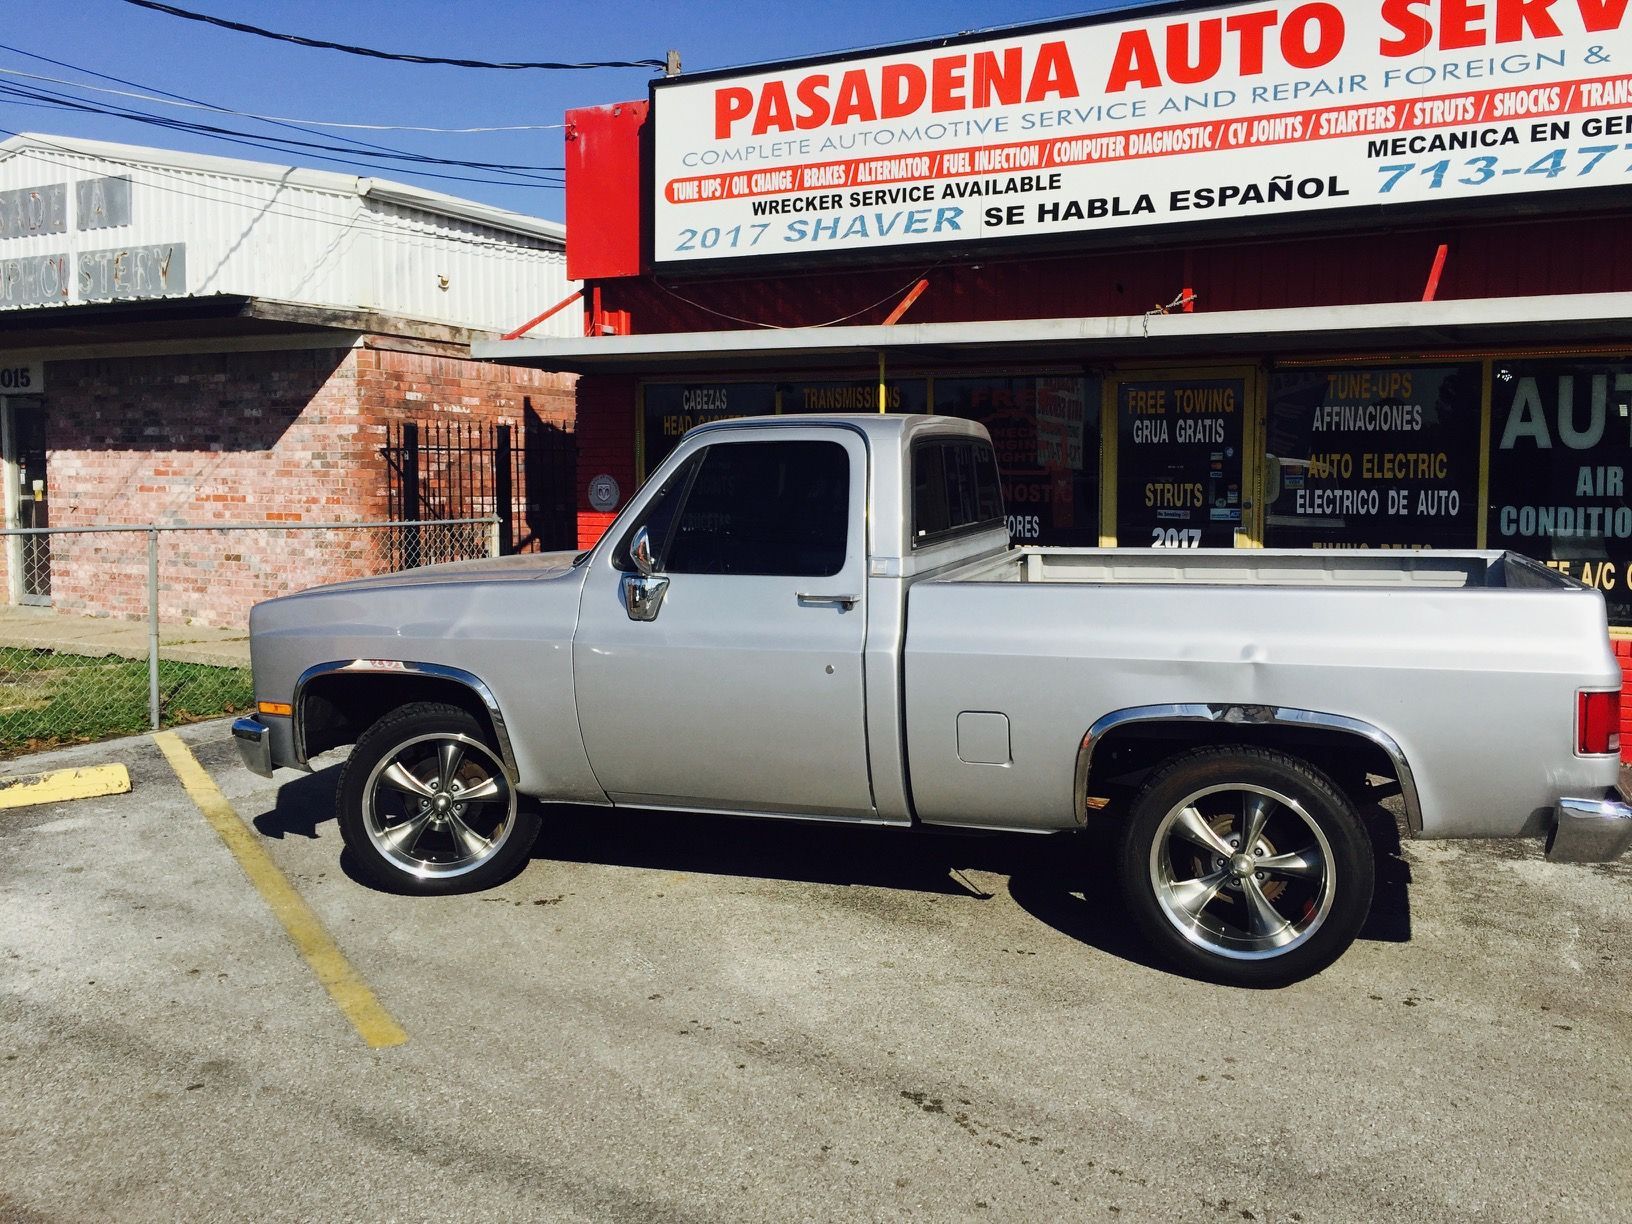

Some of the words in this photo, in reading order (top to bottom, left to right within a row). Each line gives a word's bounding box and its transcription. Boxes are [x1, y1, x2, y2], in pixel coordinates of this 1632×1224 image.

[715, 41, 1080, 139] PASADENA
[1105, 2, 1345, 93] AUTO
[682, 139, 811, 167] COMPLETE
[820, 117, 1009, 152] AUTOMOTIVE
[1021, 101, 1147, 130] SERVICE
[1158, 90, 1237, 114] AND
[1252, 74, 1369, 104] REPAIR
[1384, 49, 1566, 88] FOREIGN
[1584, 45, 1612, 64] &
[673, 182, 699, 200] TUNE
[701, 178, 721, 198] UPS
[731, 177, 749, 195] OIL
[751, 170, 793, 192] CHANGE
[803, 165, 846, 187] BRAKES
[857, 156, 930, 182] ALTERNATOR
[943, 153, 971, 174] FUEL
[974, 145, 1039, 171] INJECTION
[1053, 135, 1126, 163] COMPUTER
[1128, 125, 1212, 156] DIAGNOSTIC
[1228, 122, 1248, 145] CV
[1250, 115, 1303, 143] JOINTS
[1319, 105, 1396, 136] STARTERS
[1413, 96, 1475, 126] STRUTS
[1493, 86, 1561, 118] SHOCKS
[1367, 127, 1520, 158] MECANICA
[1530, 121, 1571, 142] EN
[1581, 115, 1632, 137] GE
[1377, 143, 1632, 193] 713-47
[752, 194, 843, 216] WRECKER
[850, 185, 935, 207] SERVICE
[942, 174, 1062, 200] AVAILABLE
[984, 205, 1025, 227] SE
[1038, 194, 1156, 223] HABLA
[1169, 174, 1350, 211] ESPAÑOL
[675, 222, 771, 251] 2017
[783, 206, 964, 242] SHAVER
[682, 388, 728, 411] CABEZAS
[1327, 372, 1413, 400] TUNE-UPS
[1127, 390, 1166, 415] FREE
[1174, 388, 1235, 414] TOWING
[1133, 419, 1169, 444] GRUA
[1176, 418, 1225, 444] GRATIS
[1312, 404, 1422, 432] AFFINACIONES
[1308, 452, 1353, 479] AUTO
[1362, 451, 1448, 479] ELECTRIC
[1145, 482, 1203, 508] STRUTS
[1575, 466, 1624, 496] AIR
[1296, 489, 1379, 515] ELECTRICO
[1388, 489, 1409, 516] DE
[1417, 490, 1460, 516] AUTO
[1151, 527, 1202, 548] 2017
[1581, 561, 1615, 591] A/C
